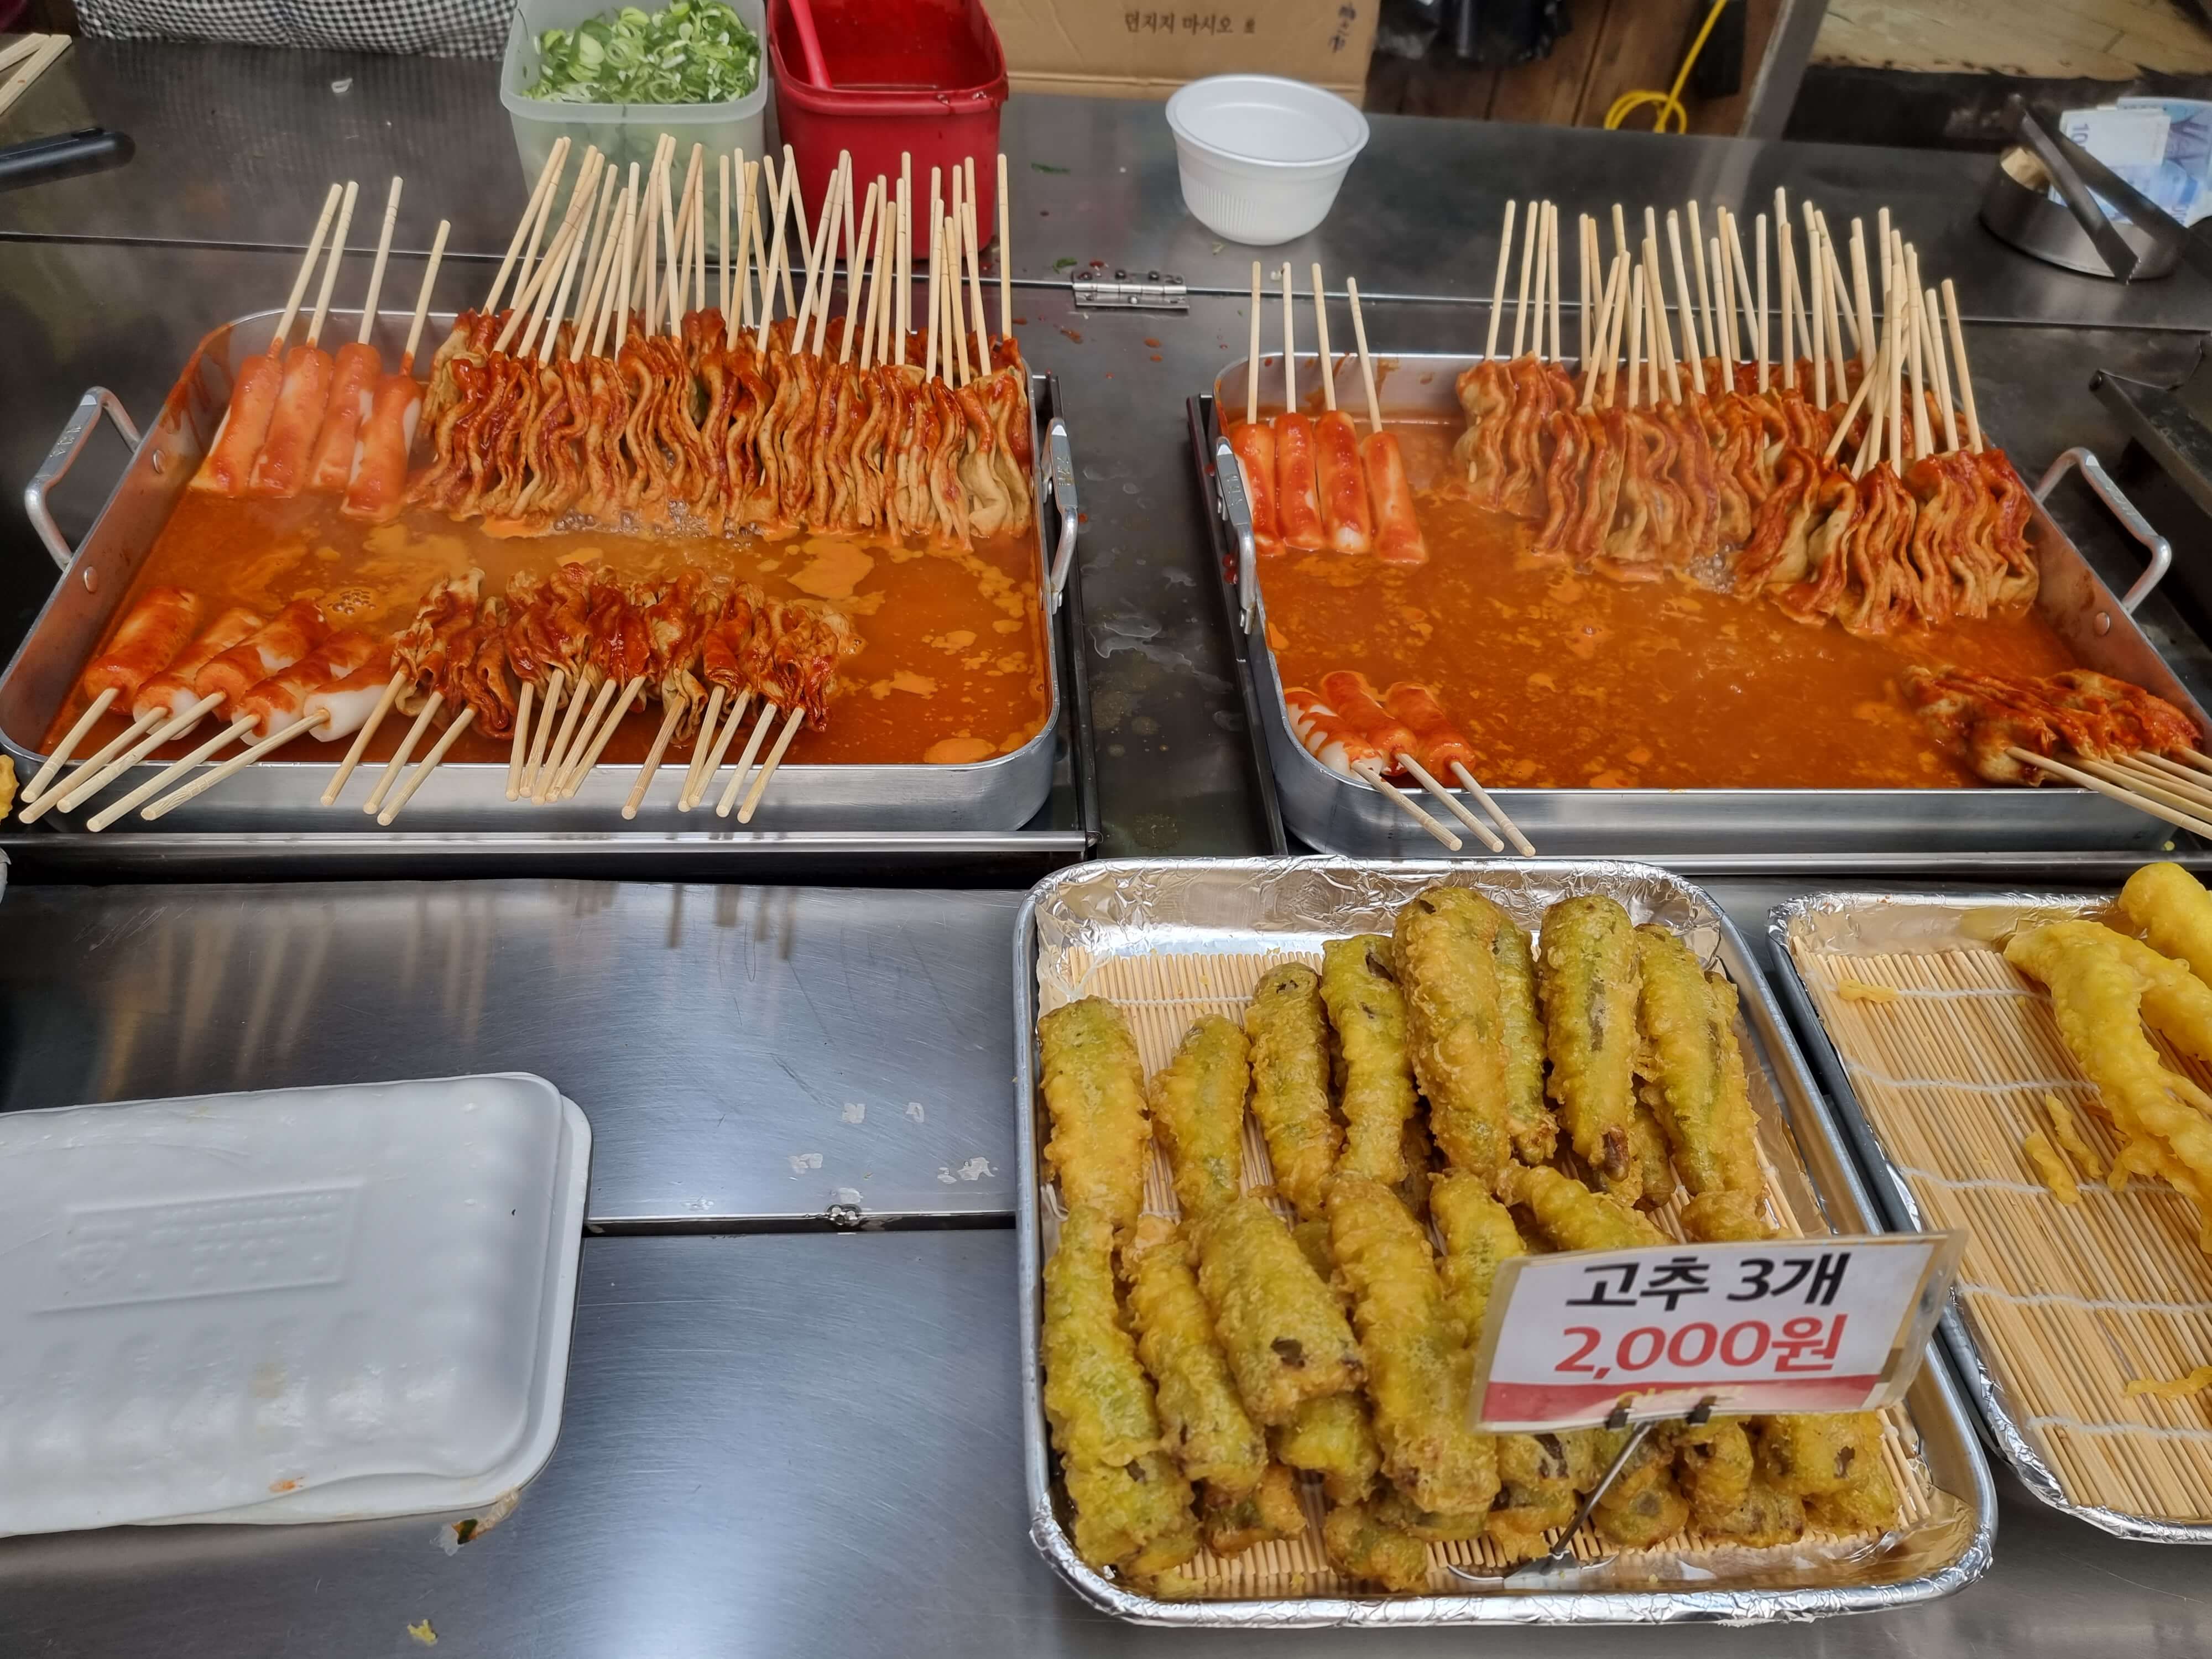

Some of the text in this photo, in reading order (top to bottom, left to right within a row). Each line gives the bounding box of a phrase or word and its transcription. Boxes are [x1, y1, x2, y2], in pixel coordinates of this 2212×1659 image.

[1182, 13, 1233, 35] 마시오
[1566, 1252, 1851, 1311] 고추 3개
[1554, 1313, 1848, 1379] 2,000원
